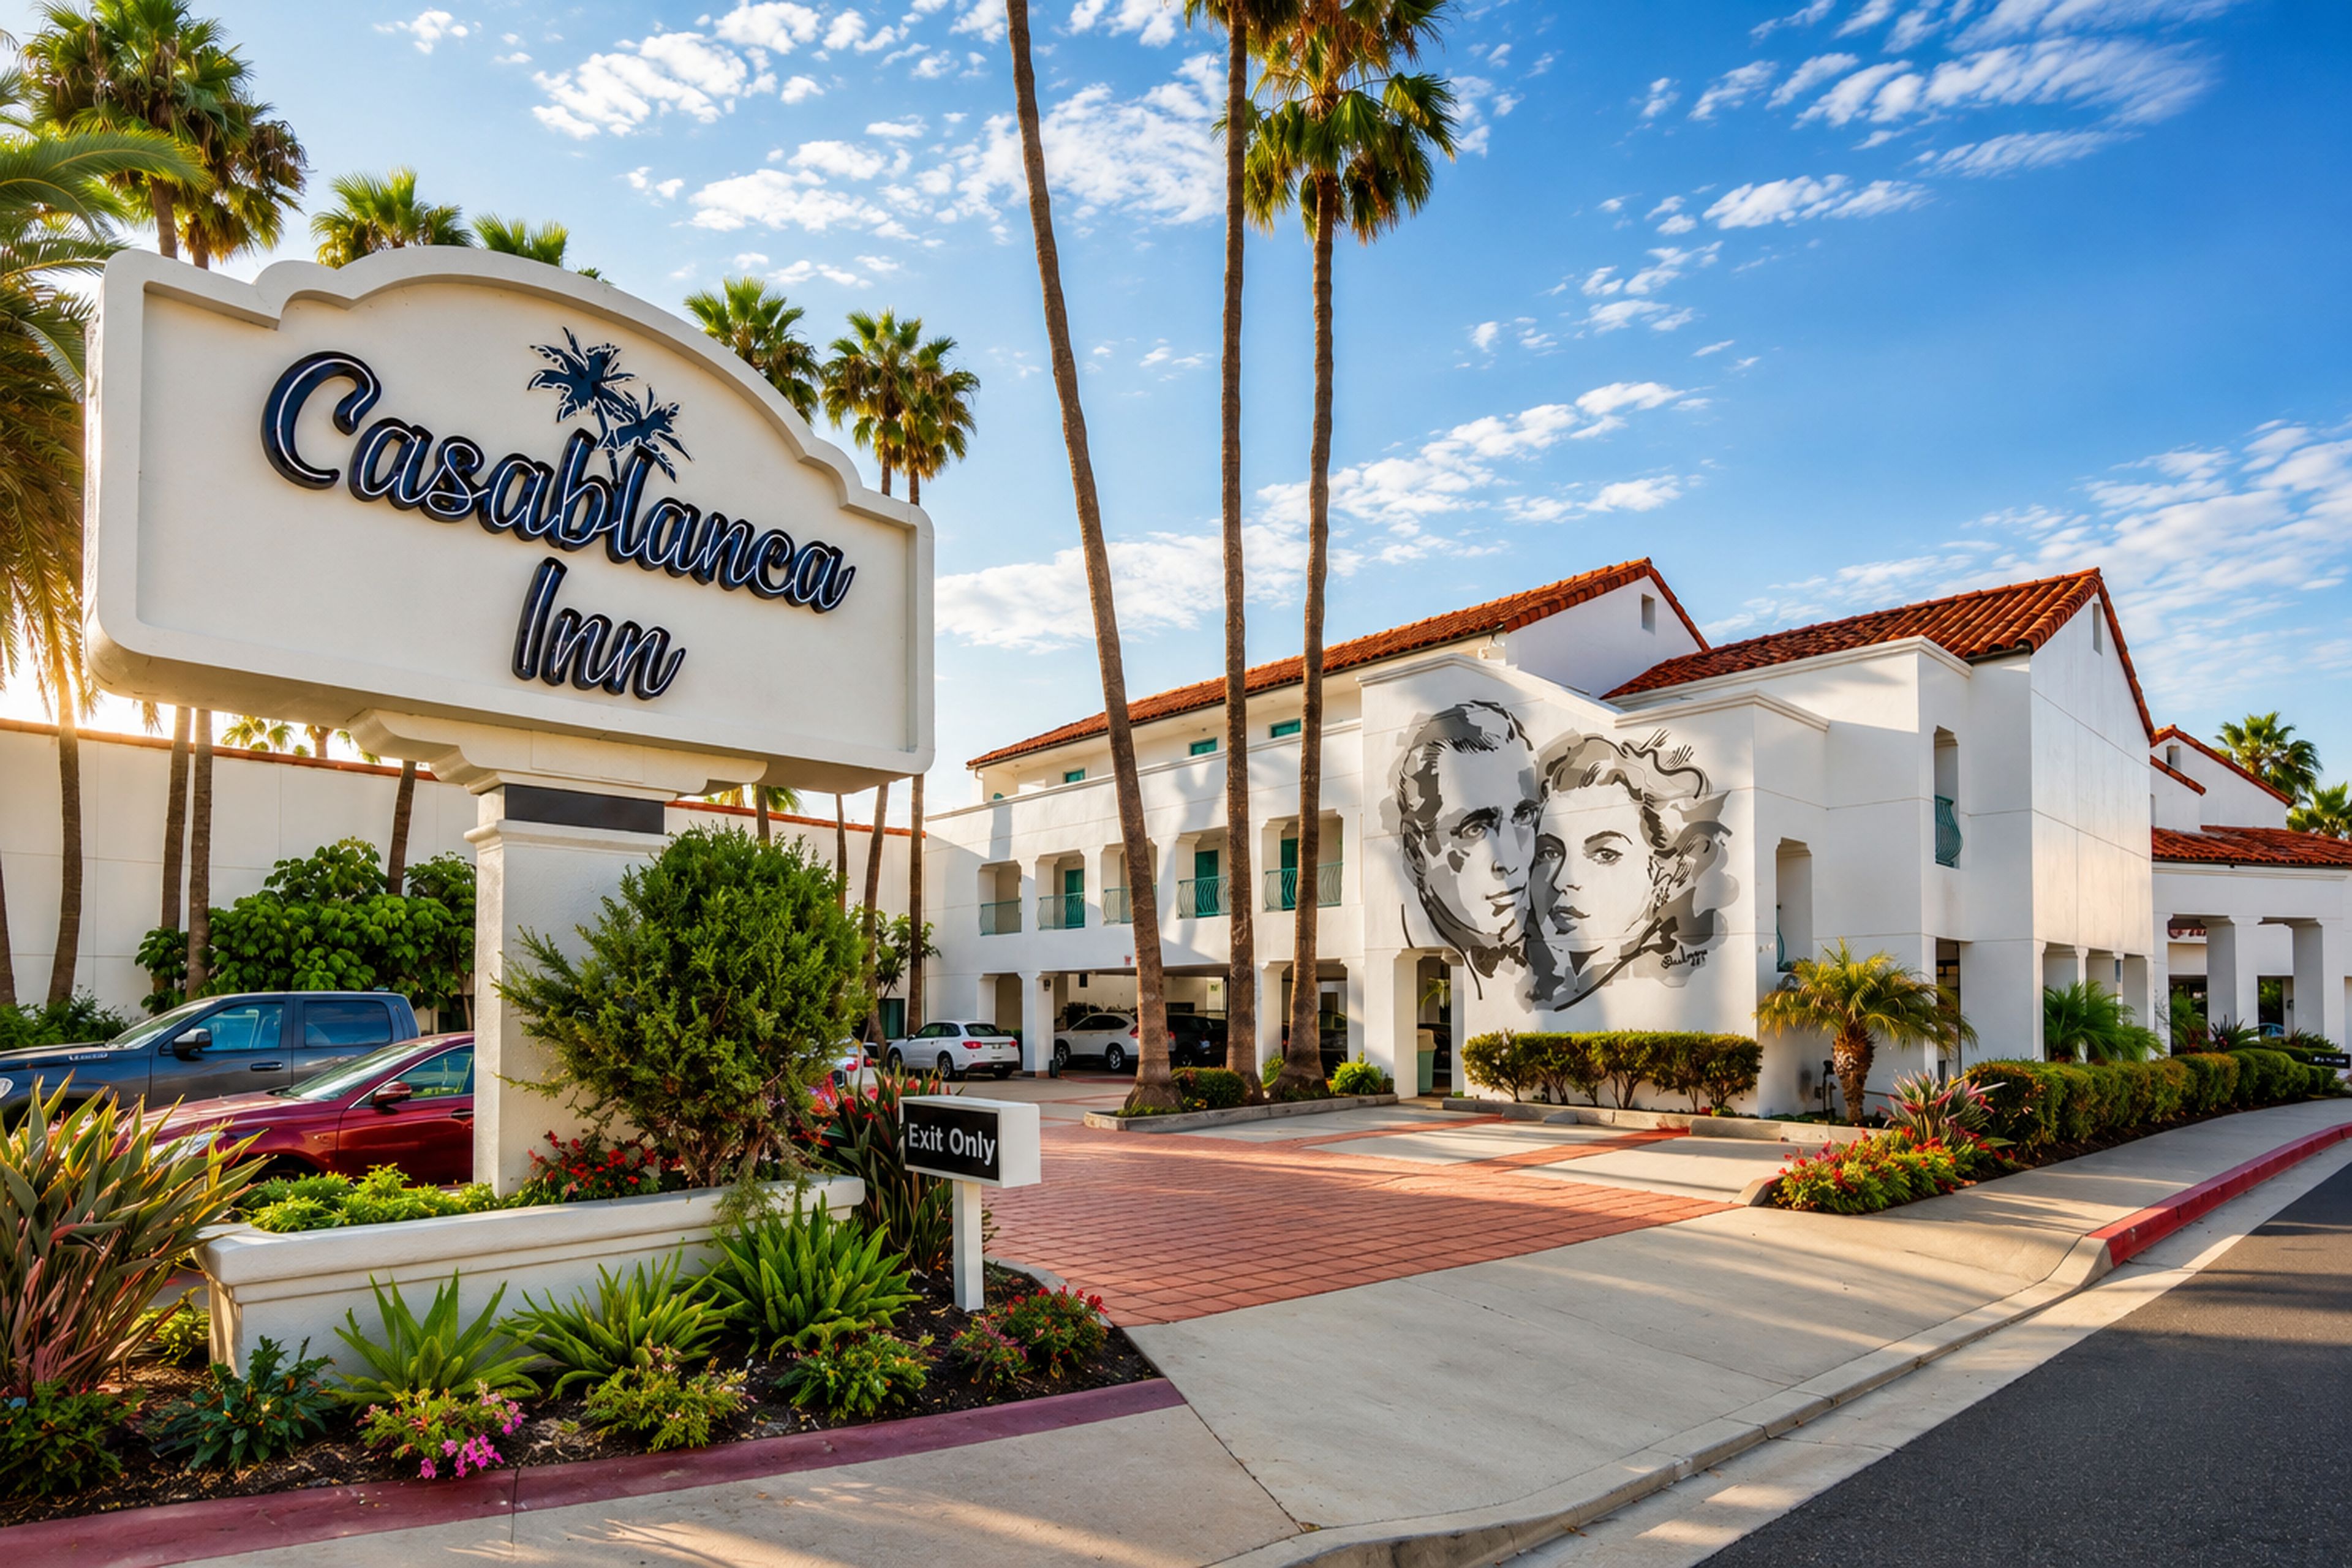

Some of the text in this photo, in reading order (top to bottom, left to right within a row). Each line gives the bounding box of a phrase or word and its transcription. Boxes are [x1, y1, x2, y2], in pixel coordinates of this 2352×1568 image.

[261, 351, 856, 613] Casablanca
[512, 557, 686, 700] Inn
[908, 1123, 995, 1166] Exit Only
